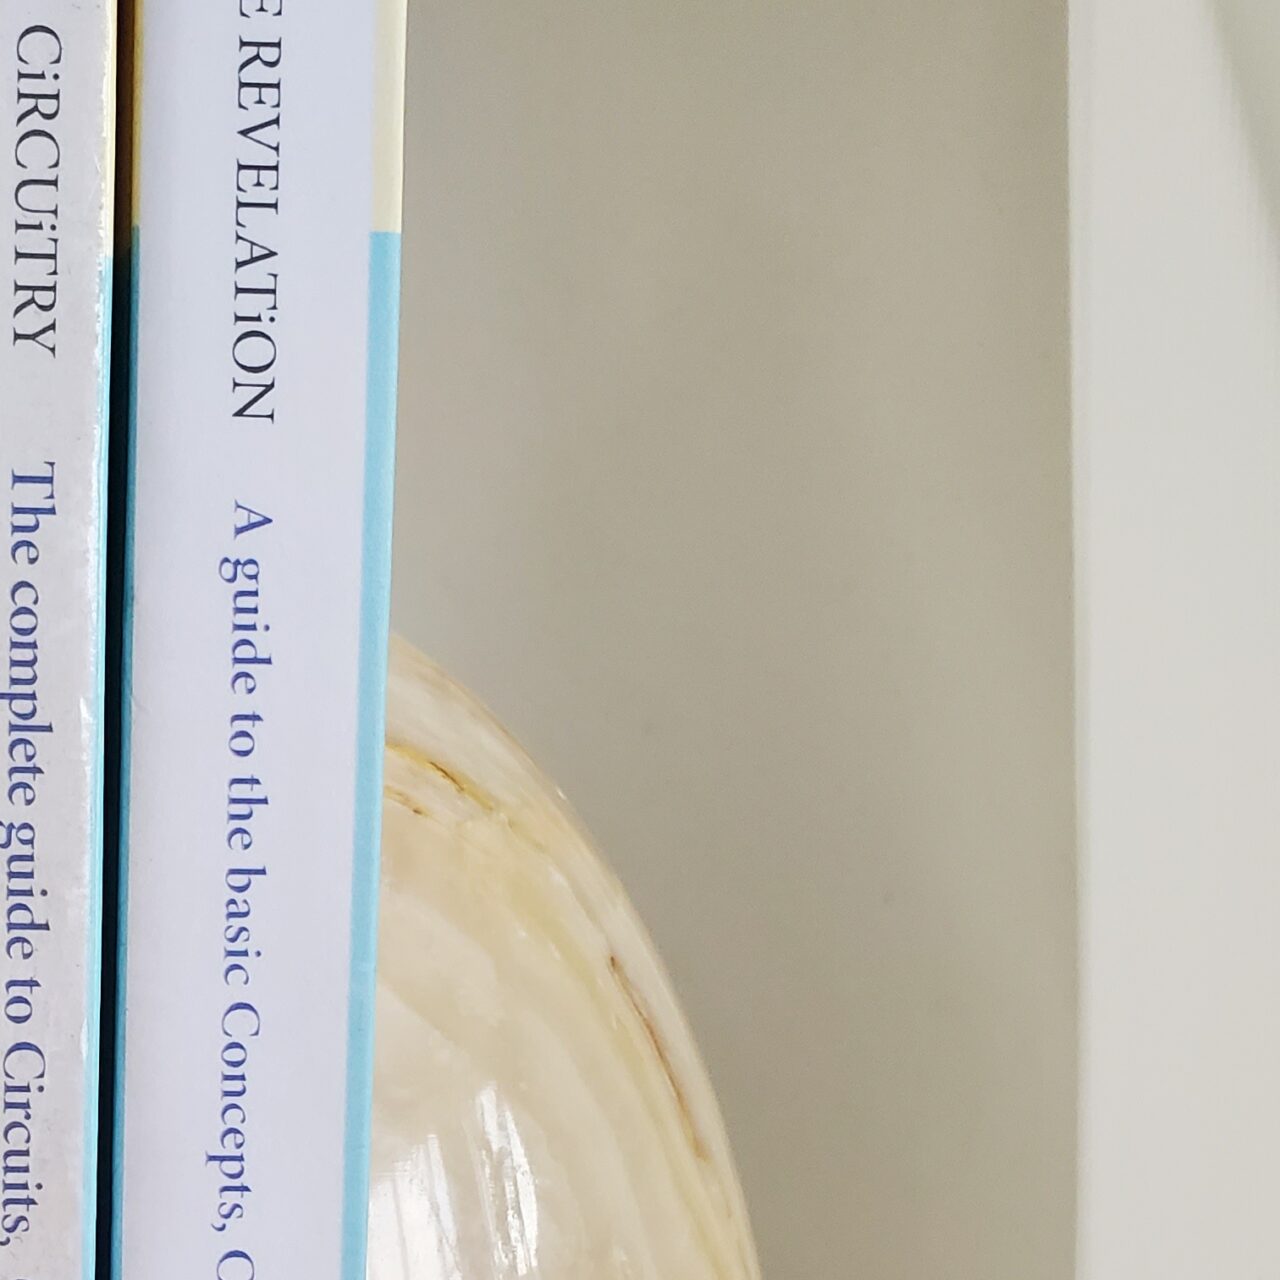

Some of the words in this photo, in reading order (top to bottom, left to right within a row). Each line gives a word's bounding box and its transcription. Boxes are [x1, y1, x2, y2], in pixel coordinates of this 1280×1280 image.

[10, 460, 57, 566] The
[233, 499, 274, 539] A
[218, 556, 273, 695] guide
[228, 711, 264, 758] to
[226, 775, 270, 851] the
[223, 865, 268, 986] basic
[3, 976, 42, 1025] to
[205, 1001, 261, 1232] Concepts,
